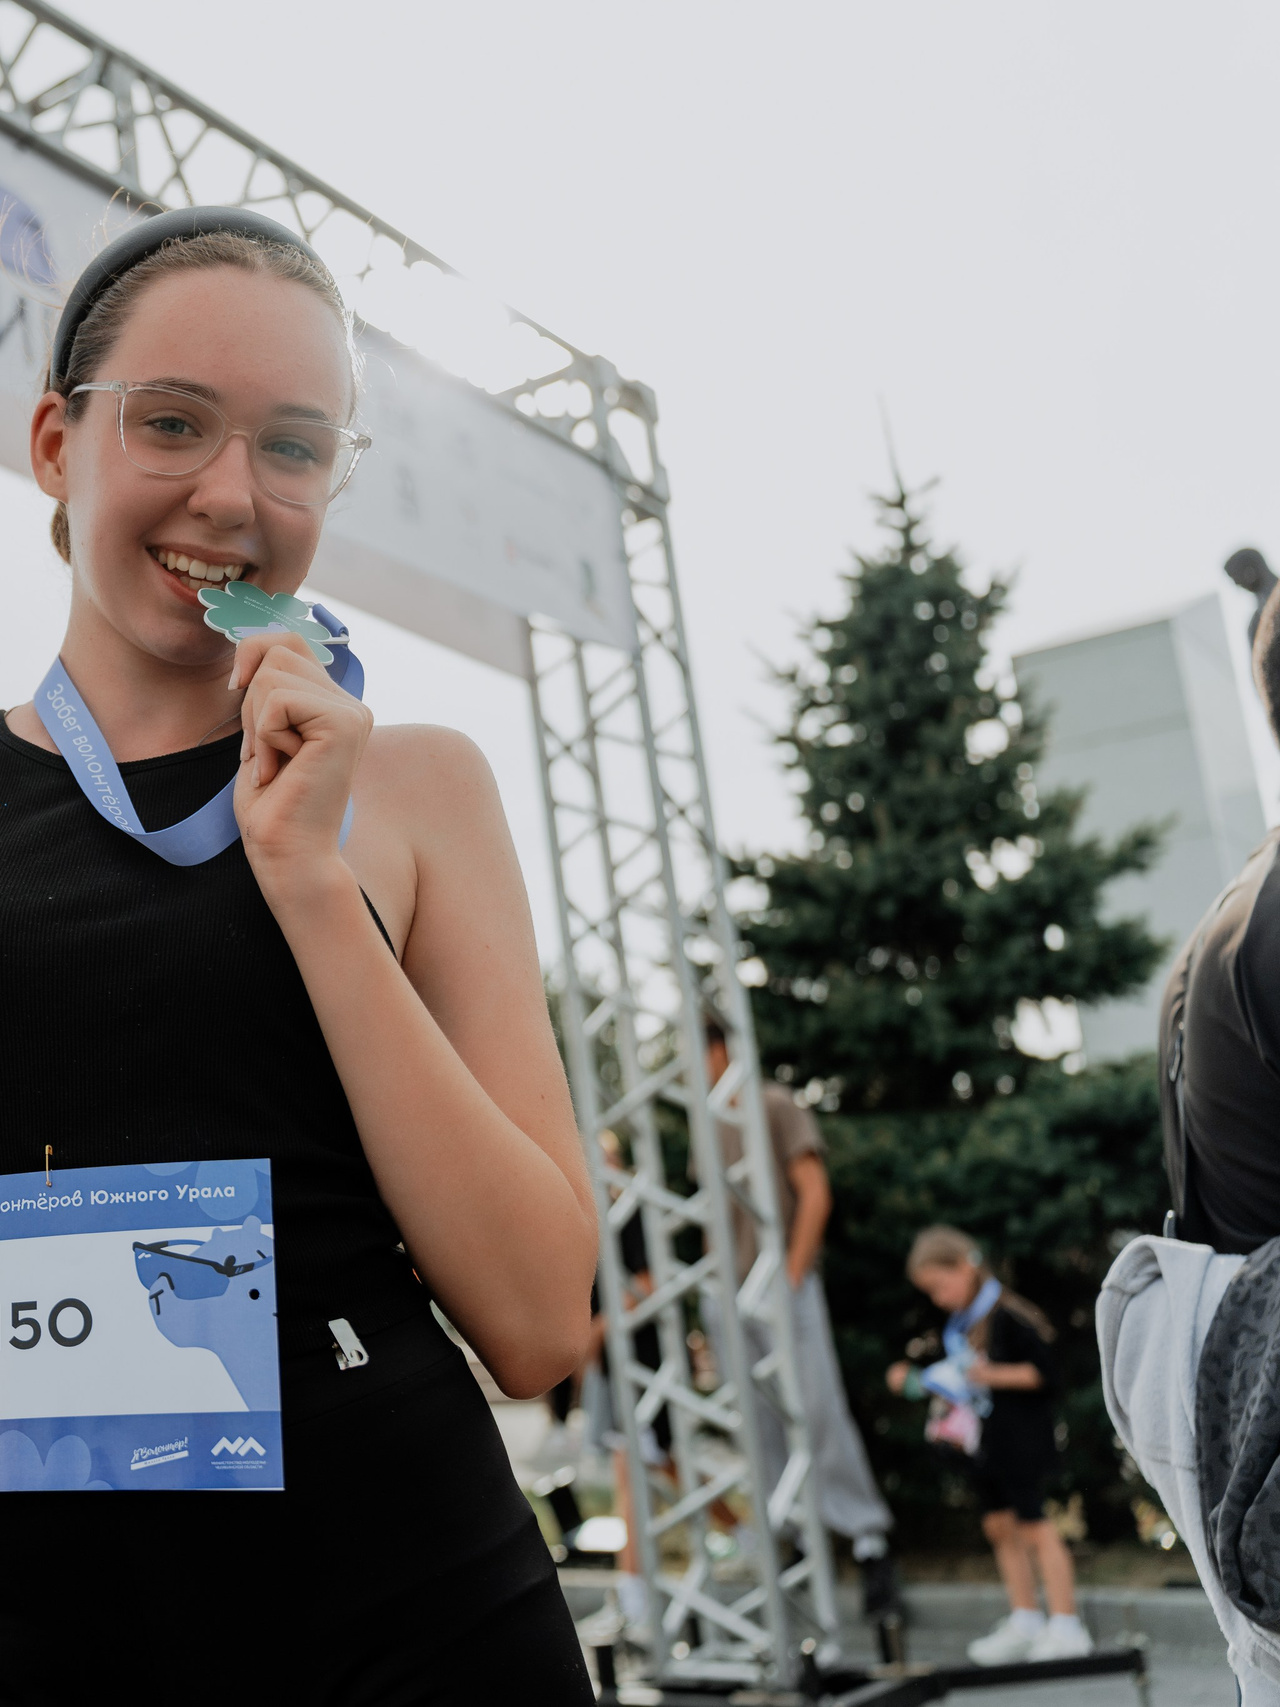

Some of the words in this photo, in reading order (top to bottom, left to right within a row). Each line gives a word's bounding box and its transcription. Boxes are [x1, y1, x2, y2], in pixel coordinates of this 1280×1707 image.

[47, 683, 82, 732] Забег
[90, 1189, 169, 1205] Южного
[175, 1184, 236, 1203] Урала
